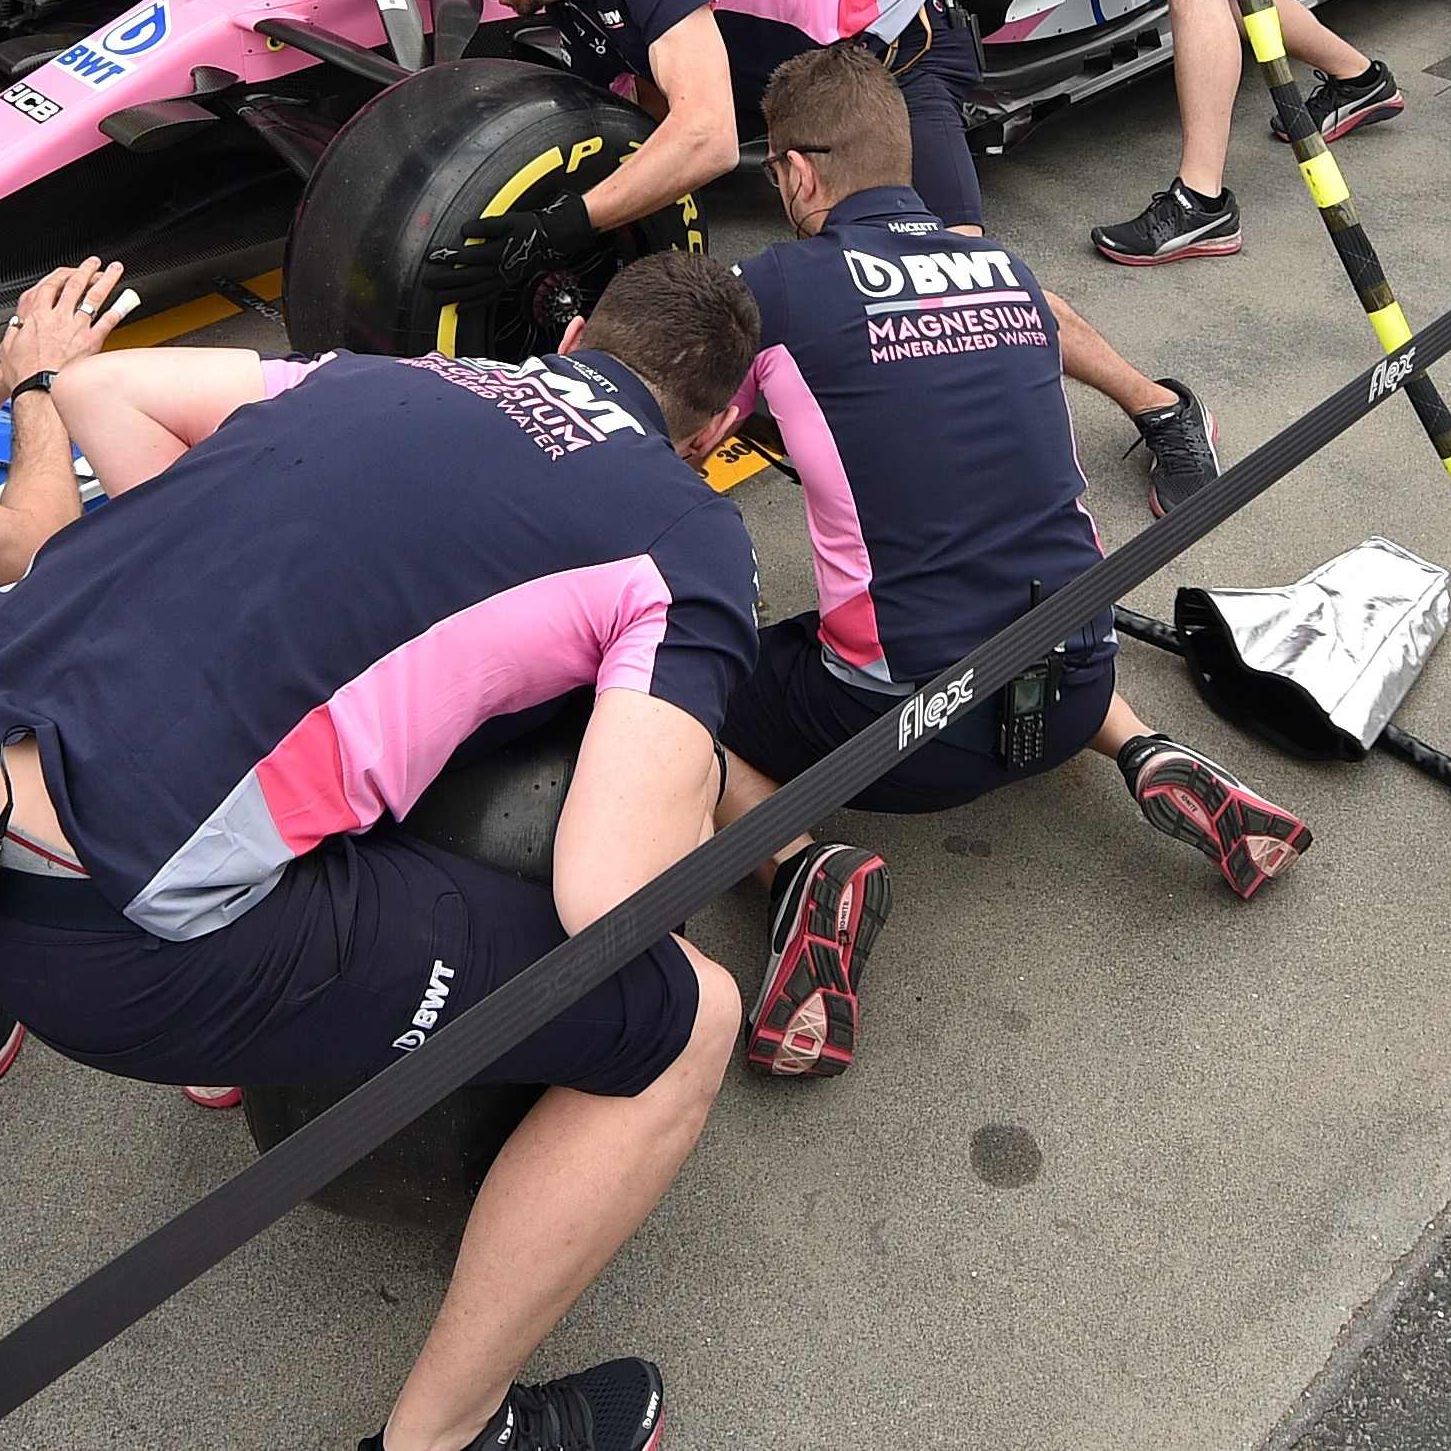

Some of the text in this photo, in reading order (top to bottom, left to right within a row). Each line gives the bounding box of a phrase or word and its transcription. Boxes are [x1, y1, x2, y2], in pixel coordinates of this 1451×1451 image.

[56, 44, 125, 86] BWT
[3, 83, 61, 123] JCB
[887, 222, 939, 233] HACKETT
[899, 250, 1020, 295] BWT
[867, 306, 1042, 345] MAGNESIUM
[870, 330, 1048, 364] MINERALIZED WATER
[1368, 346, 1416, 404] flex
[496, 398, 565, 461] WATER
[717, 440, 755, 466] 30
[898, 668, 976, 751] flex
[411, 958, 455, 1030] BWT
